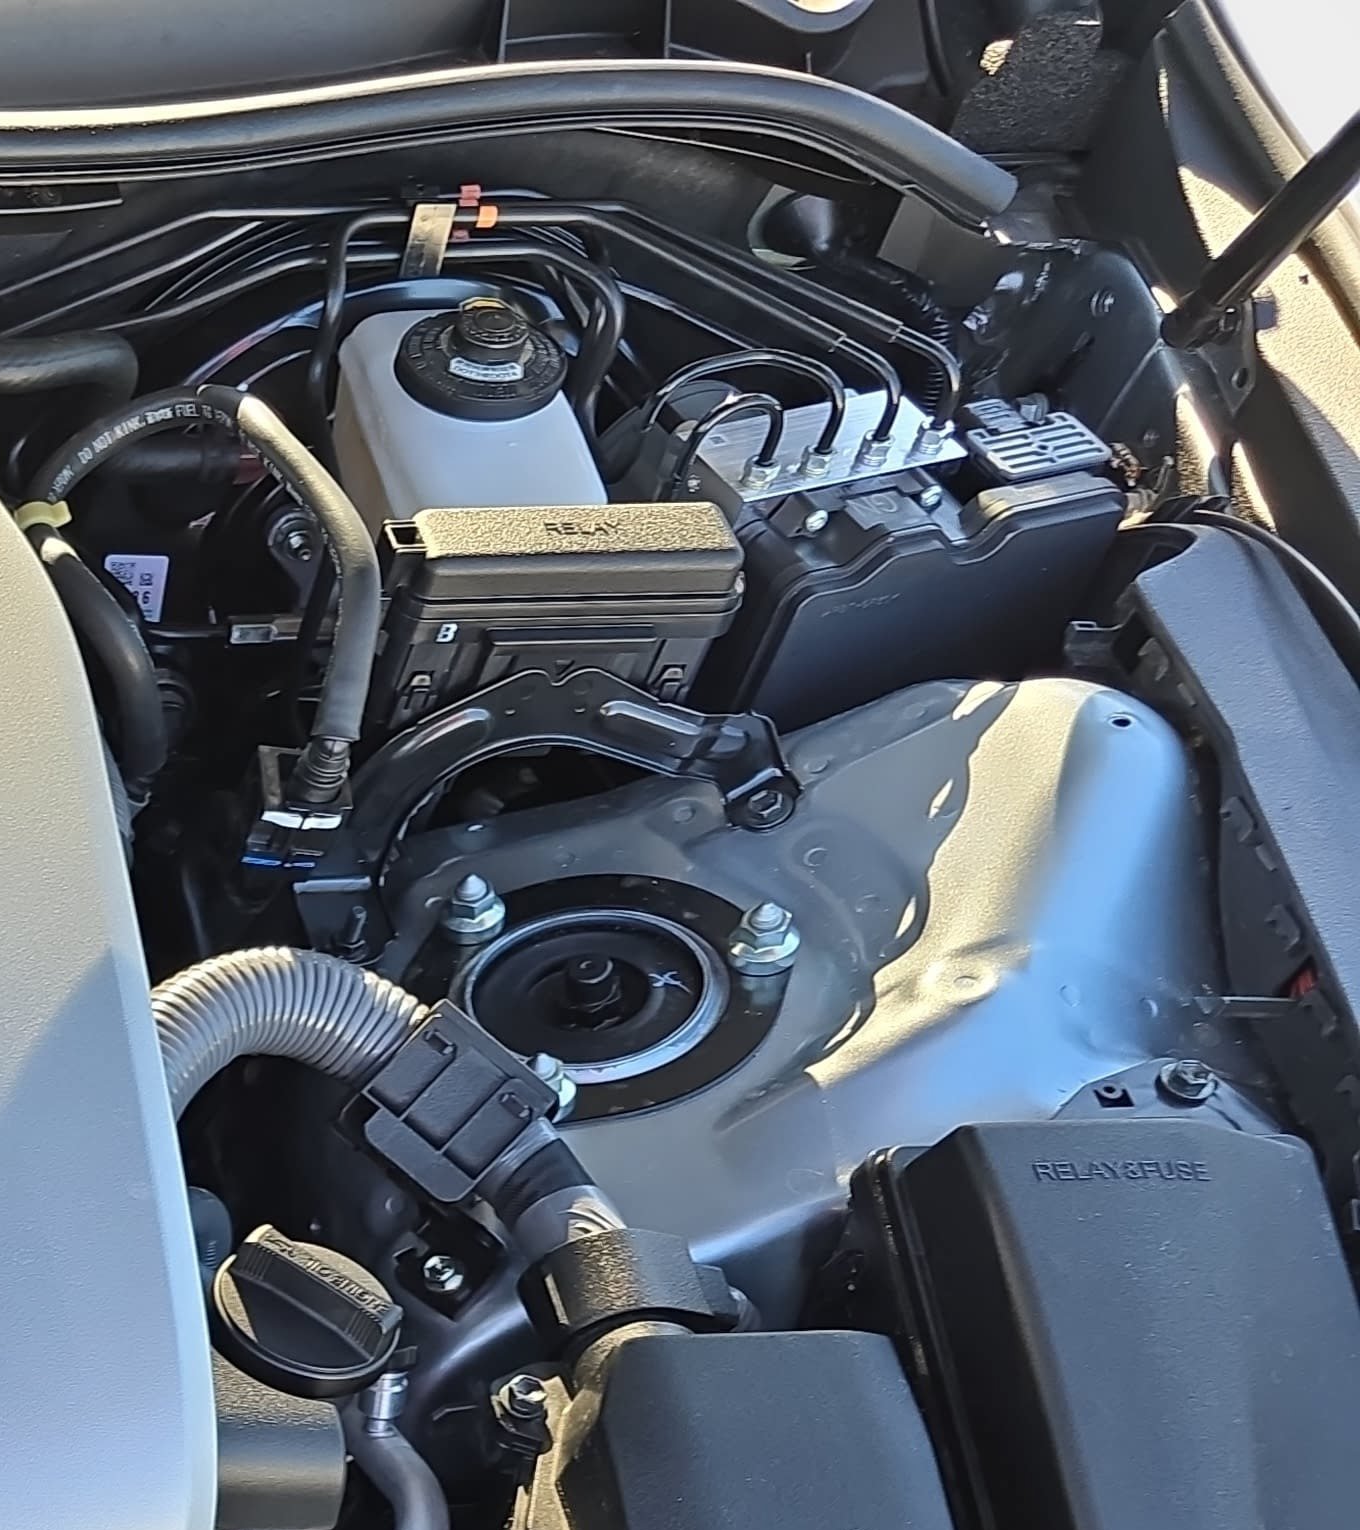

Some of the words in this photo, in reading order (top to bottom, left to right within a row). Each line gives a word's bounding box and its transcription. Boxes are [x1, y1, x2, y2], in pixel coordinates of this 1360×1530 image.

[175, 403, 200, 417] FUEL
[542, 520, 619, 536] RELAY
[434, 622, 458, 643] B
[1032, 1159, 1212, 1182] RELAY&FUSE
